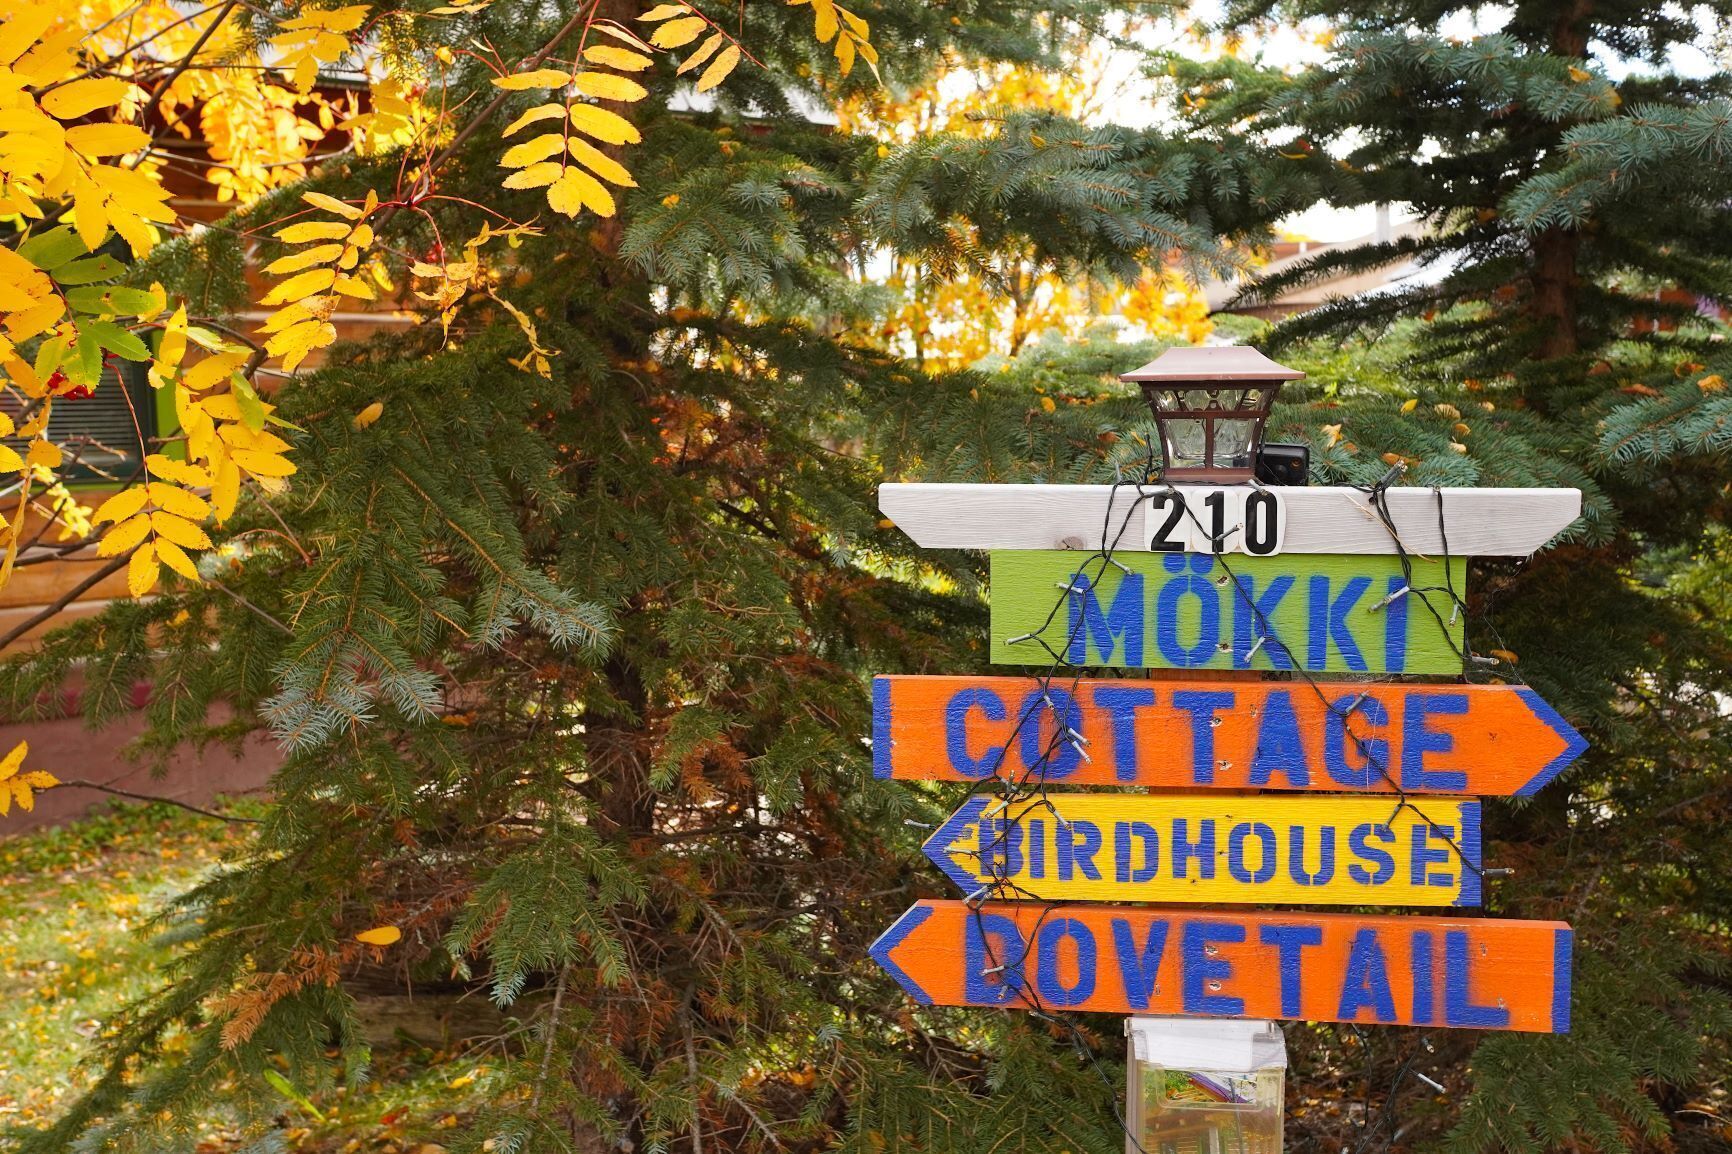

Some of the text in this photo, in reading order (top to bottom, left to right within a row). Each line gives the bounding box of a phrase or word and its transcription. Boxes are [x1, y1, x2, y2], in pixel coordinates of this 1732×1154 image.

[1150, 490, 1278, 556] 210
[1066, 553, 1411, 673] MÖKKI
[945, 687, 1471, 791] COTTAGE
[978, 818, 1457, 888] BIRDHOUSE
[964, 914, 1511, 1029] DOVETAIL
